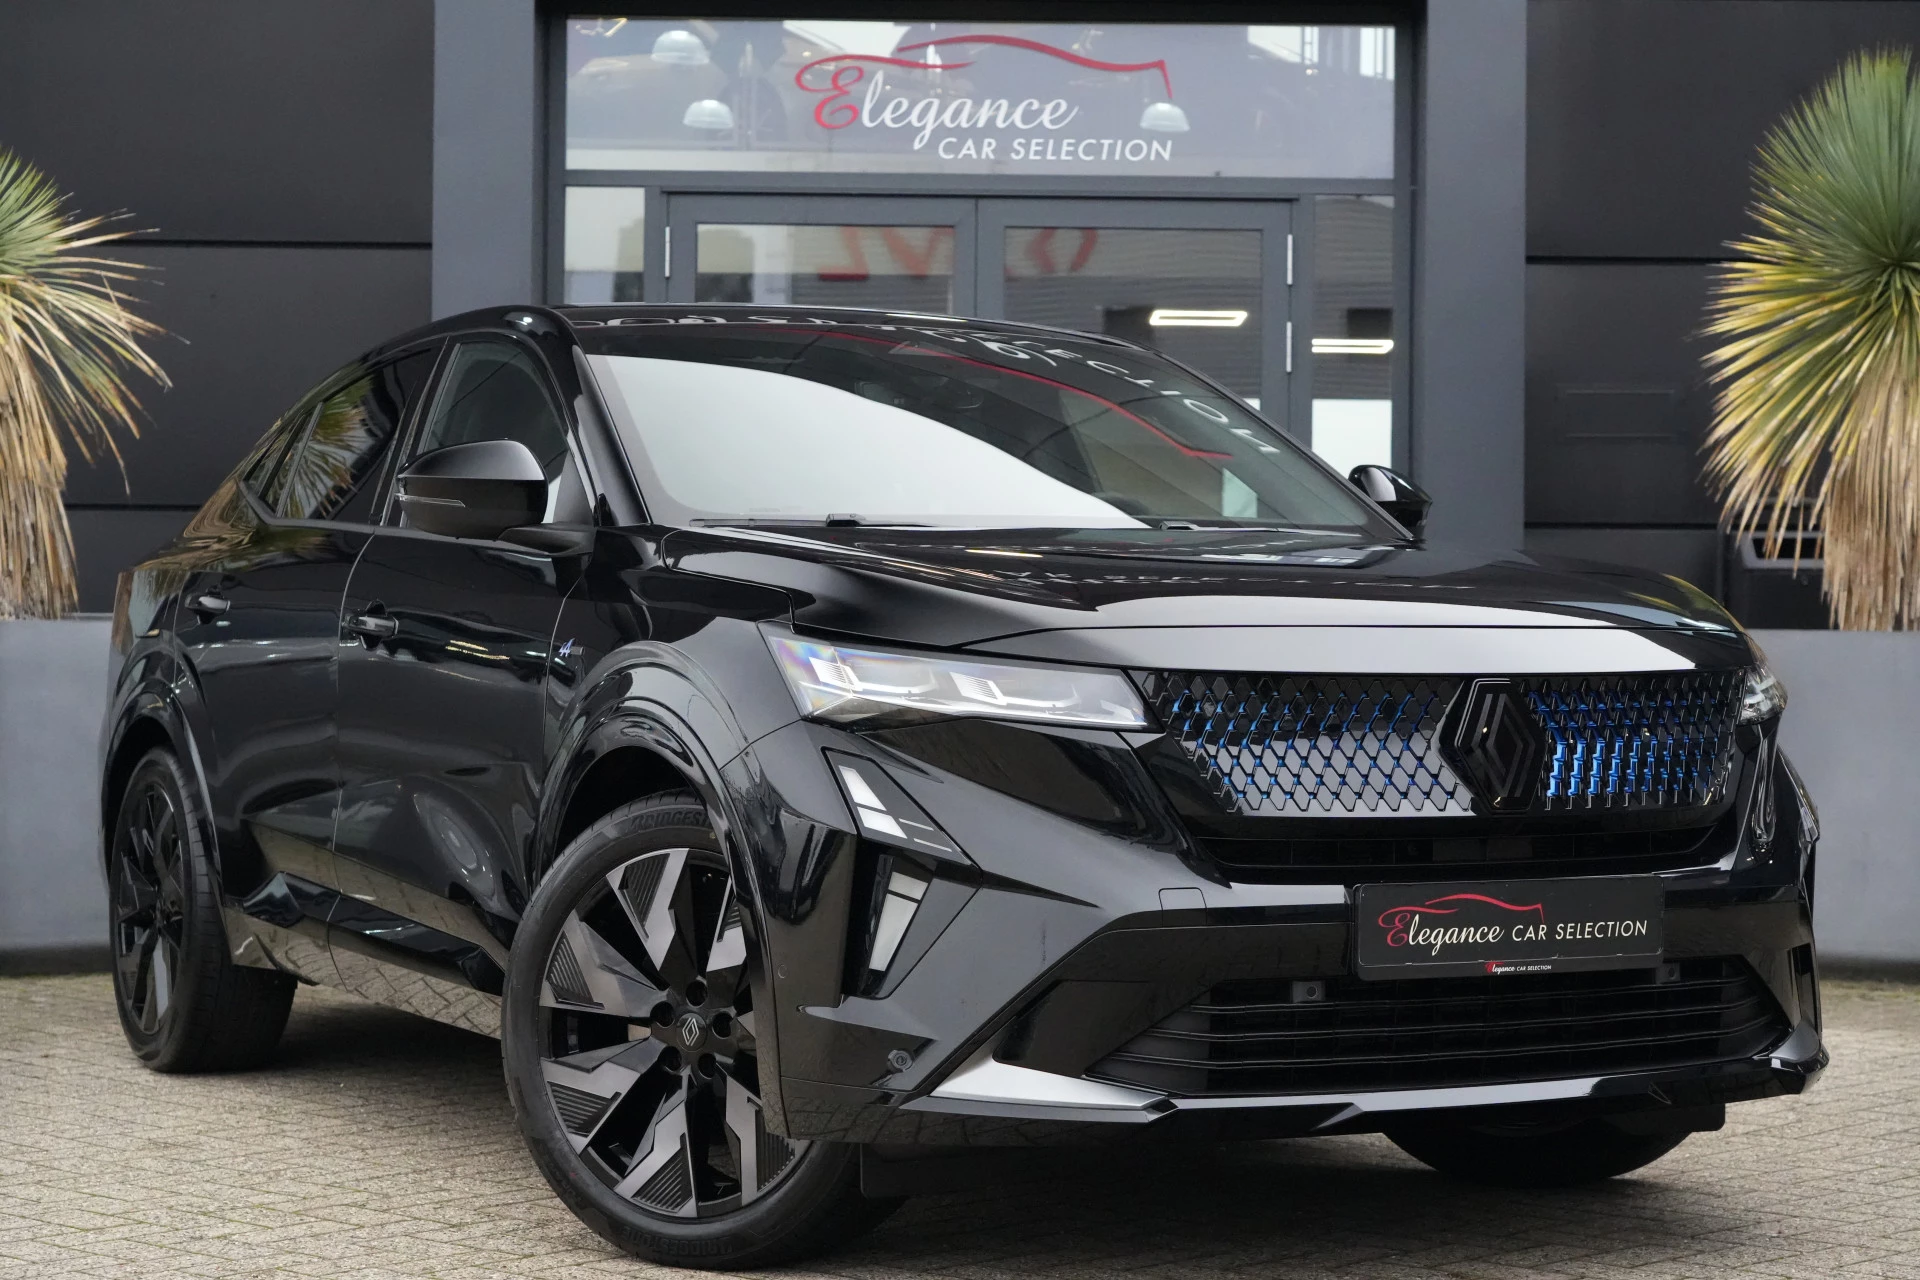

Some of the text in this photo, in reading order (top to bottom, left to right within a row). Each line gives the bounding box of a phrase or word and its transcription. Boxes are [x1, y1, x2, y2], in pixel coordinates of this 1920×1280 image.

[797, 64, 1080, 151] Elegance
[937, 137, 1173, 161] CAR SELECTION
[628, 810, 711, 831] BRIDGEST
[1379, 910, 1648, 956] Elegance CAR SELECTION
[1527, 964, 1552, 972] SELECTION
